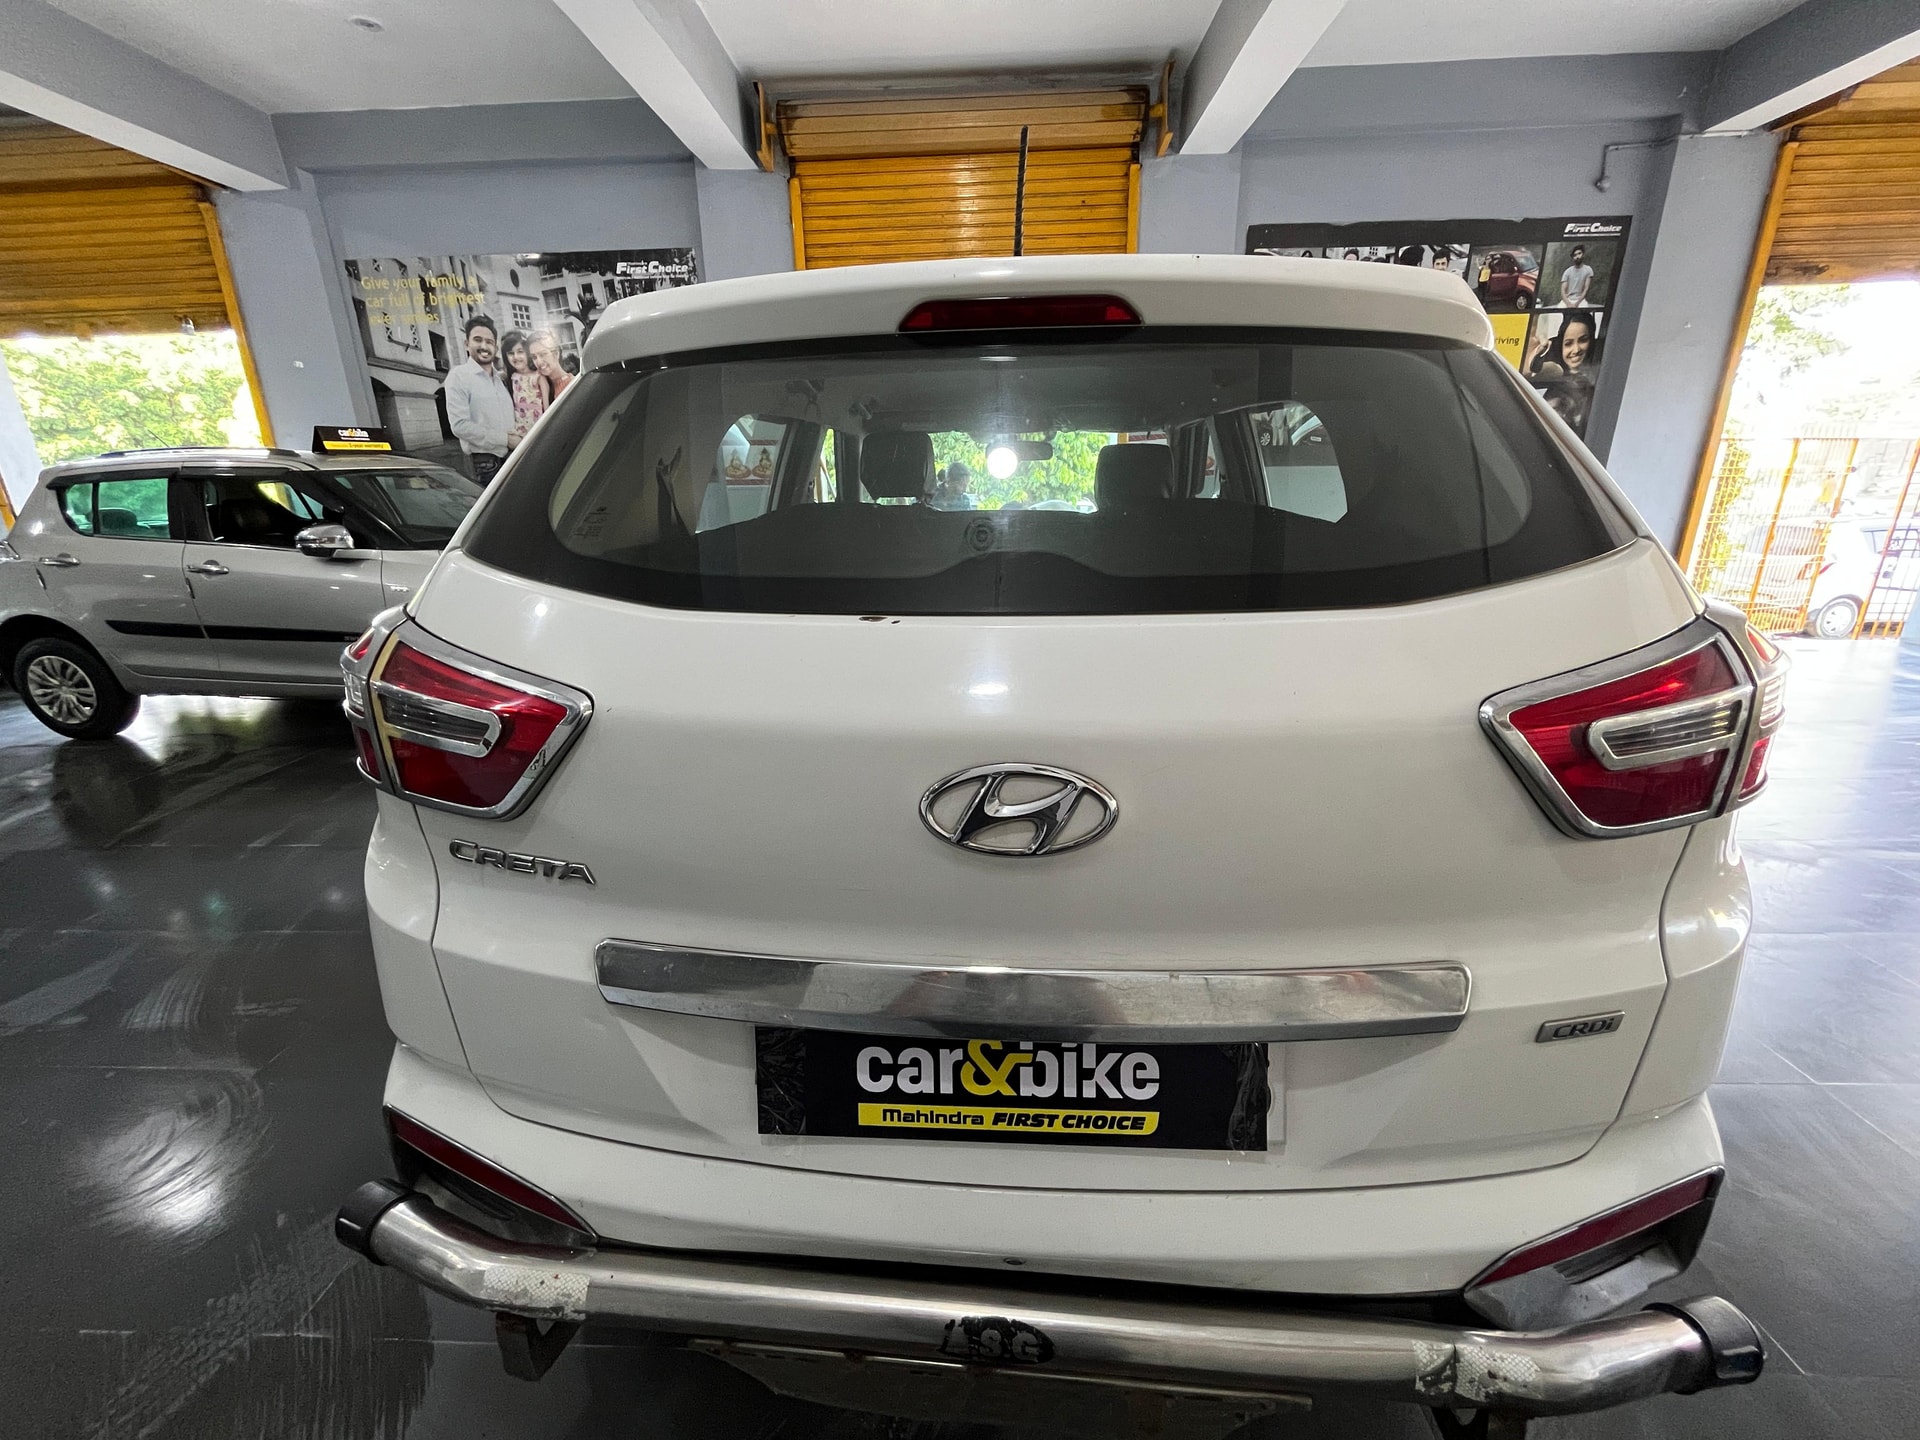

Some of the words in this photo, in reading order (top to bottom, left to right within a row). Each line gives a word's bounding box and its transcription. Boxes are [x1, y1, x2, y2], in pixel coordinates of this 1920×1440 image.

[361, 276, 390, 290] Give
[393, 277, 421, 292] your
[426, 272, 465, 290] family
[366, 296, 385, 308] car
[1495, 335, 1520, 347] riving
[449, 838, 597, 885] CRETA
[856, 1039, 1160, 1101] car&bike
[882, 1108, 985, 1126] Mahindra
[991, 1111, 1061, 1129] FIRST
[1061, 1114, 1147, 1131] CHOICE
